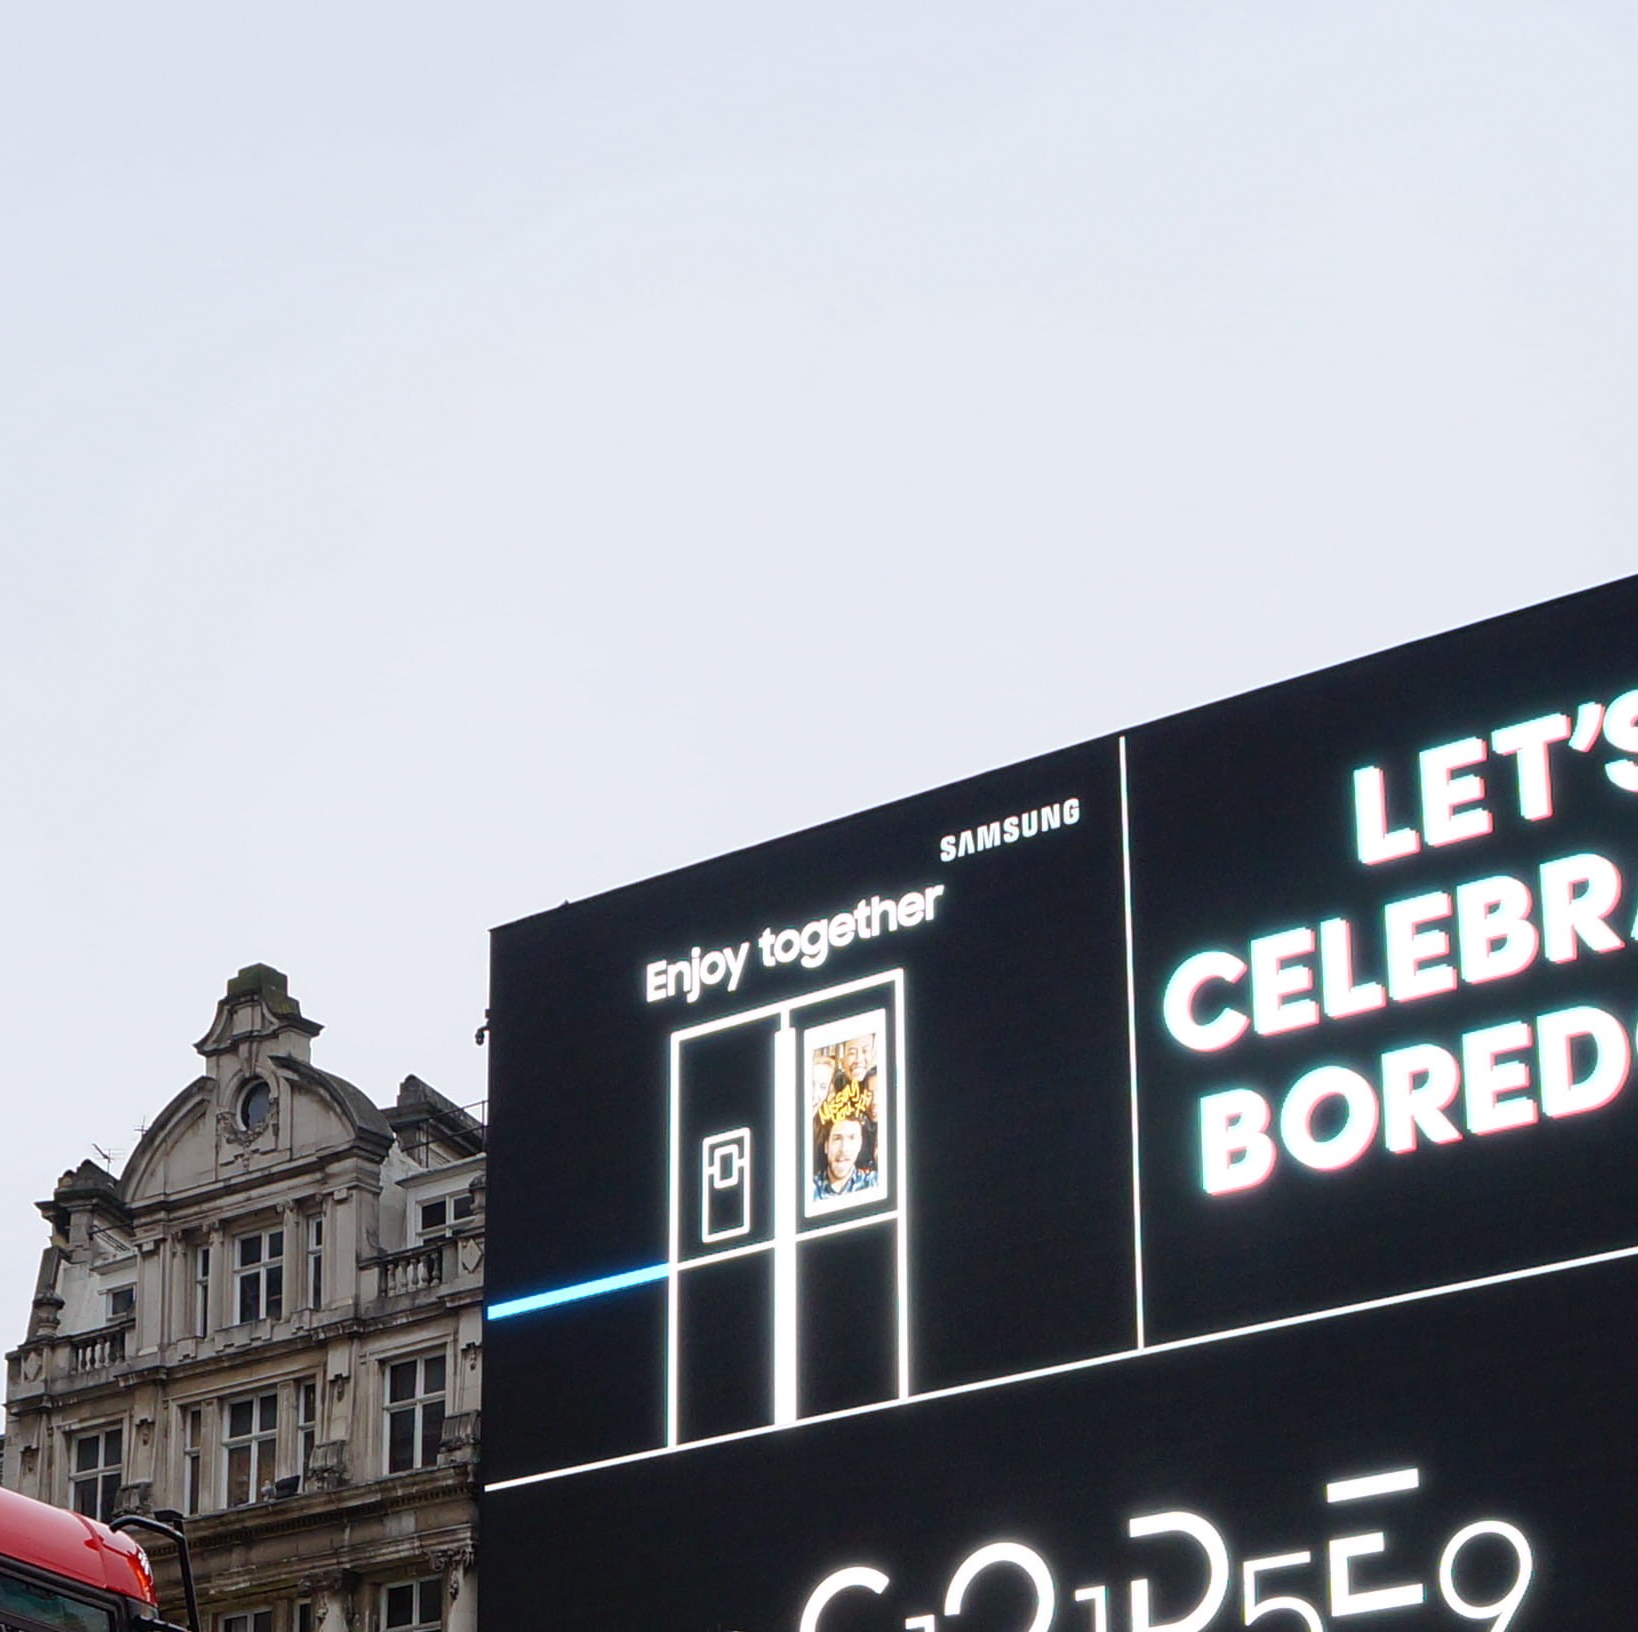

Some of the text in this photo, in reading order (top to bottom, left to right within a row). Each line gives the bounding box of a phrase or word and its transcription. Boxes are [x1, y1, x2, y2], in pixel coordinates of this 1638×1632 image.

[939, 797, 1081, 862] SAMSUNG
[645, 884, 946, 1004] Enjoy together
